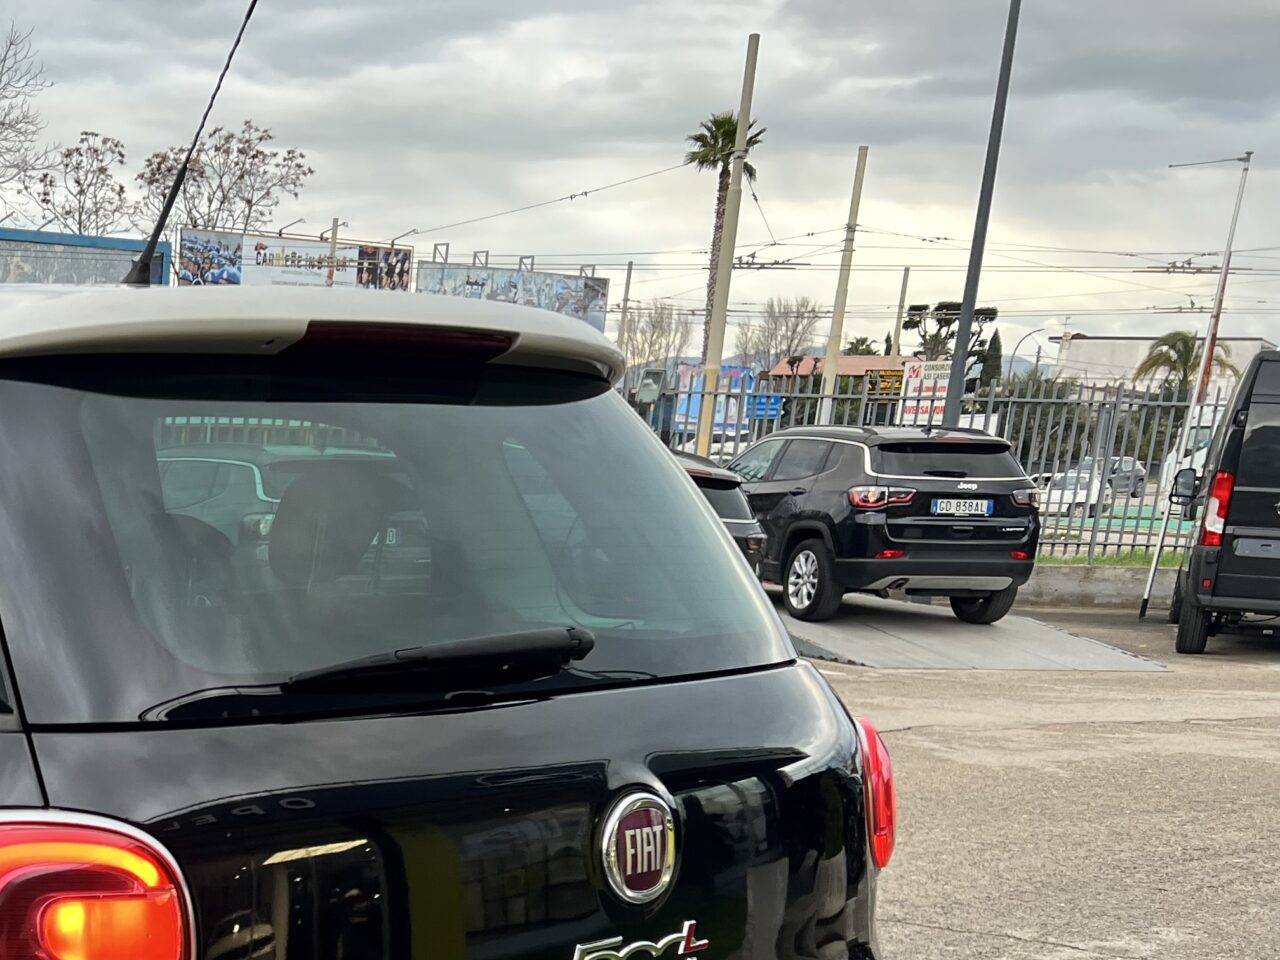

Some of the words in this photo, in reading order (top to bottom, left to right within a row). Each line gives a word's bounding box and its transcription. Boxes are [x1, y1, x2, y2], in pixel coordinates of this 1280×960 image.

[957, 482, 978, 490] Jeep
[956, 501, 986, 512] 838AL
[625, 825, 664, 875] FIAT
